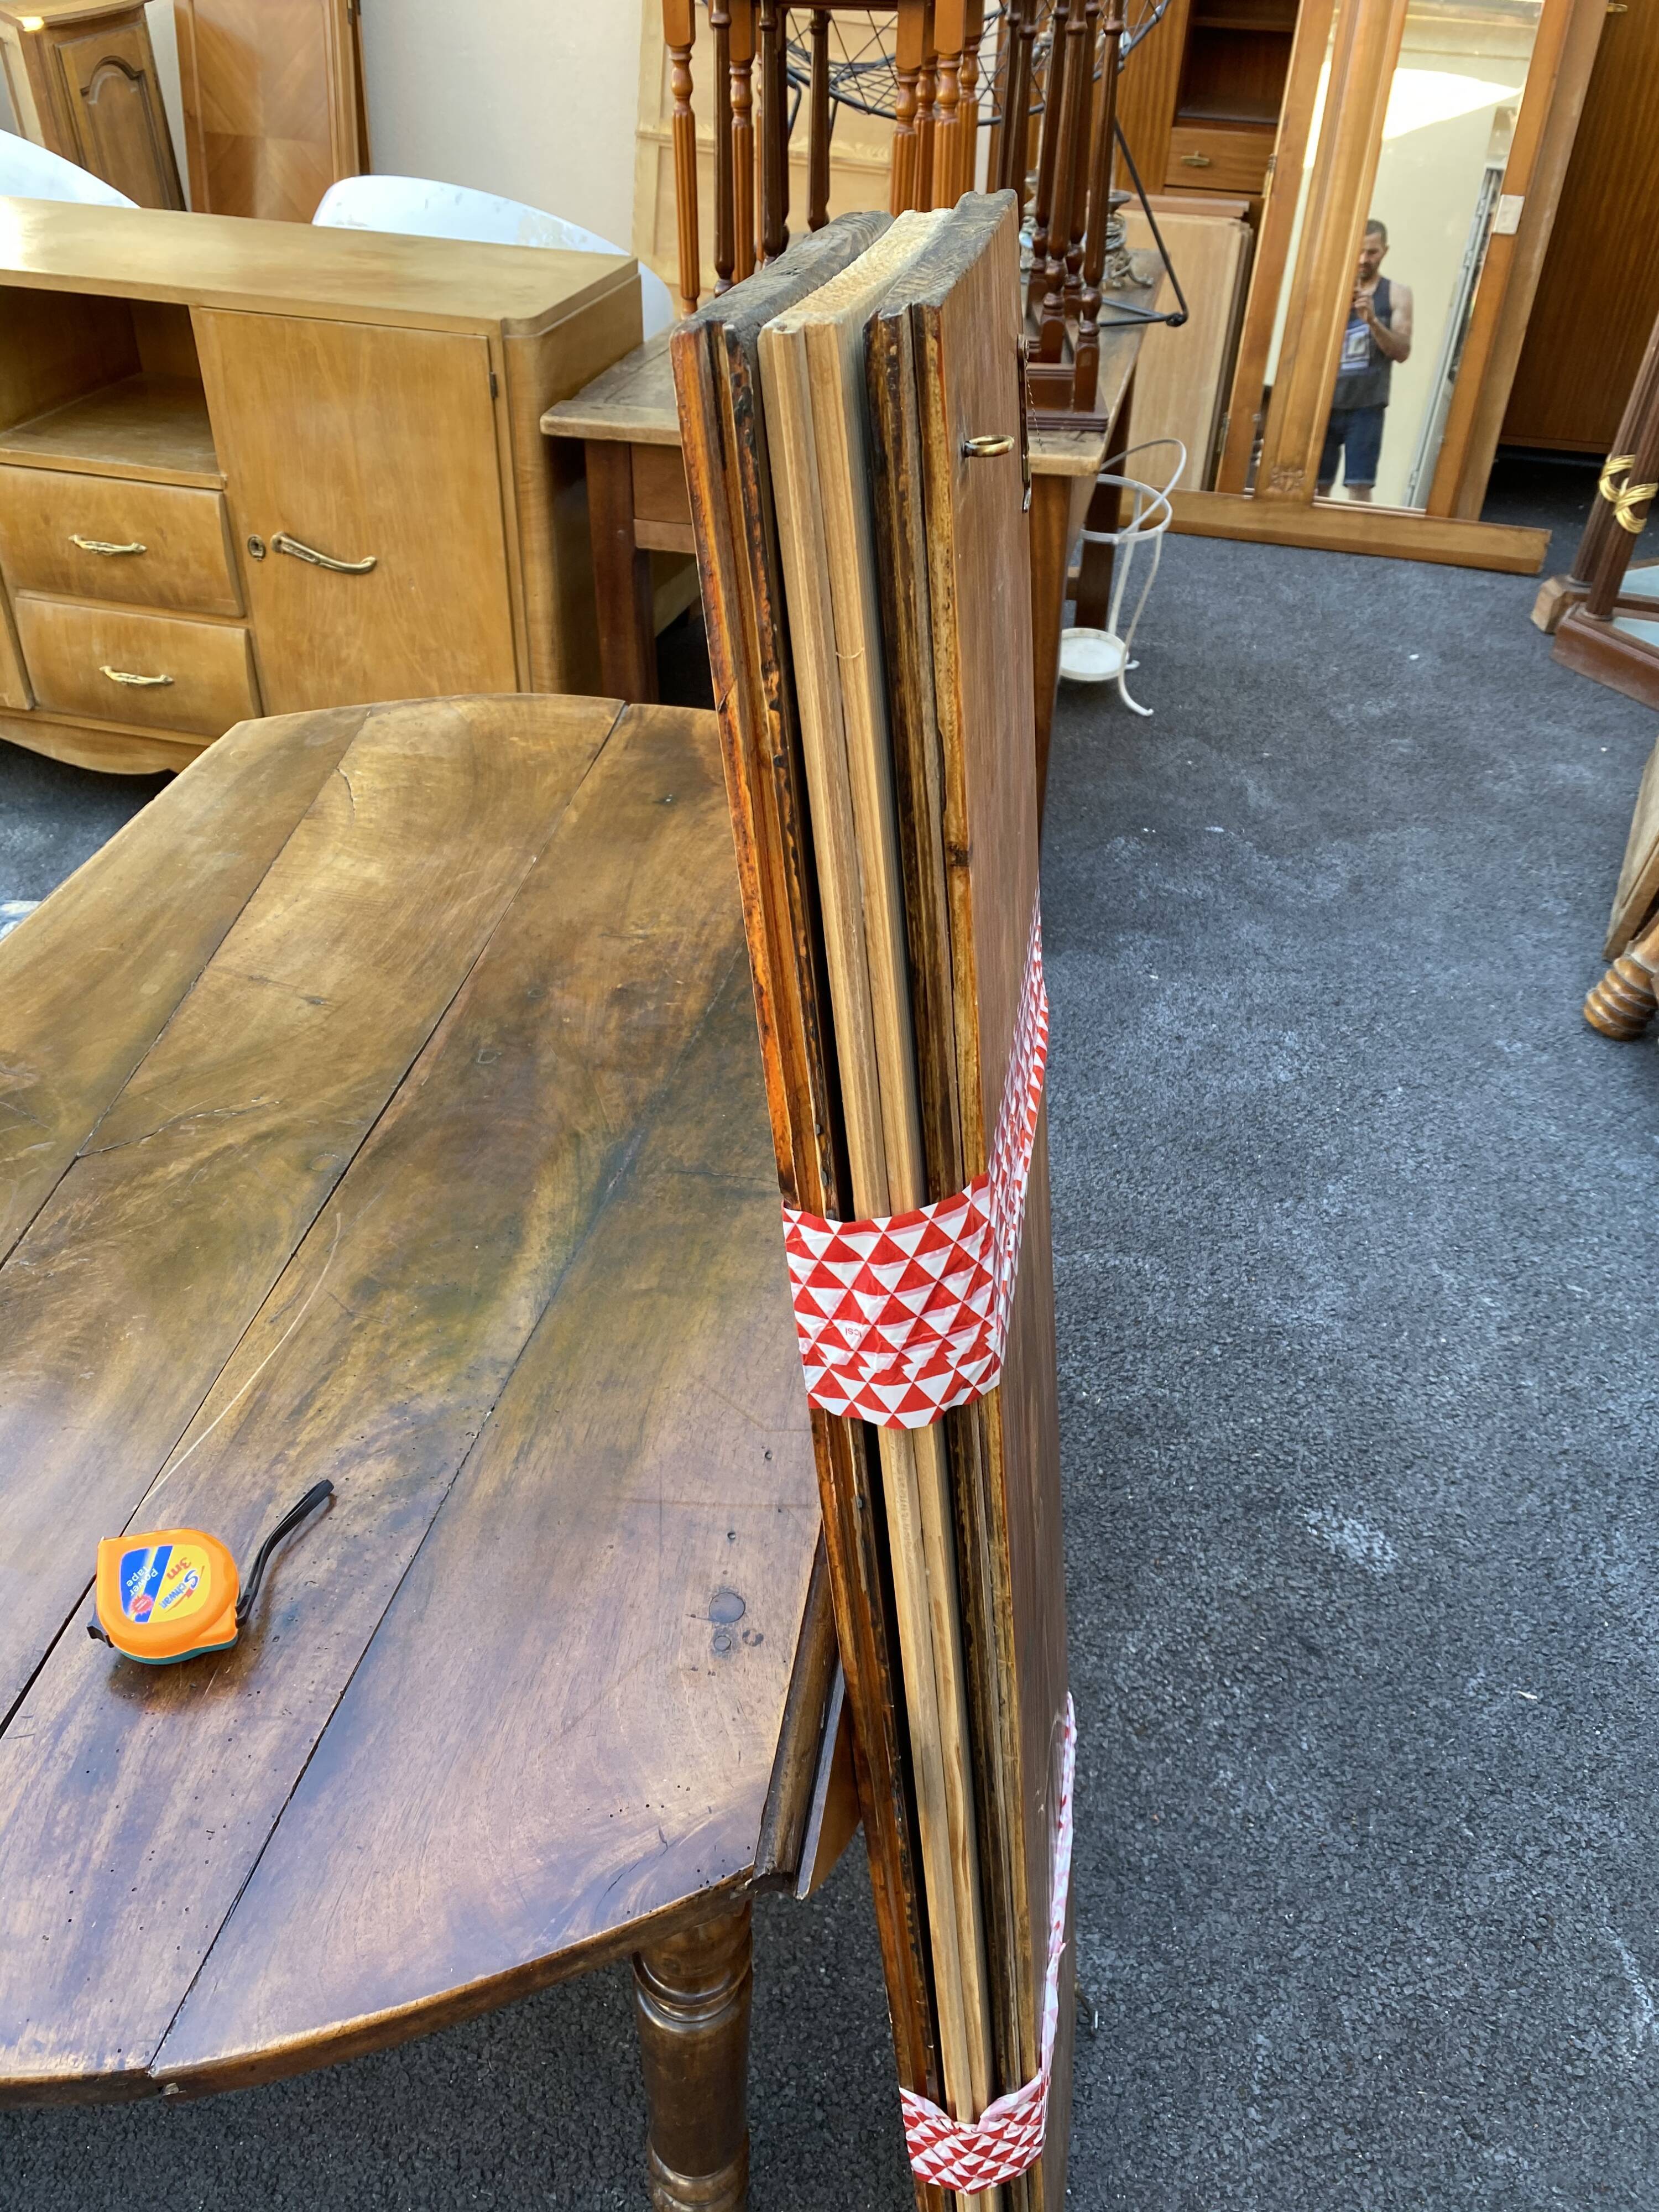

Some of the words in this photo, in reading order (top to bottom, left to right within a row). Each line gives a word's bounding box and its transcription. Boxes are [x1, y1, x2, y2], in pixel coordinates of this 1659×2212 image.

[126, 1566, 151, 1587] Tape
[166, 1557, 191, 1580] 3m
[131, 1567, 159, 1597] Power
[159, 1568, 199, 1609] Schwan
